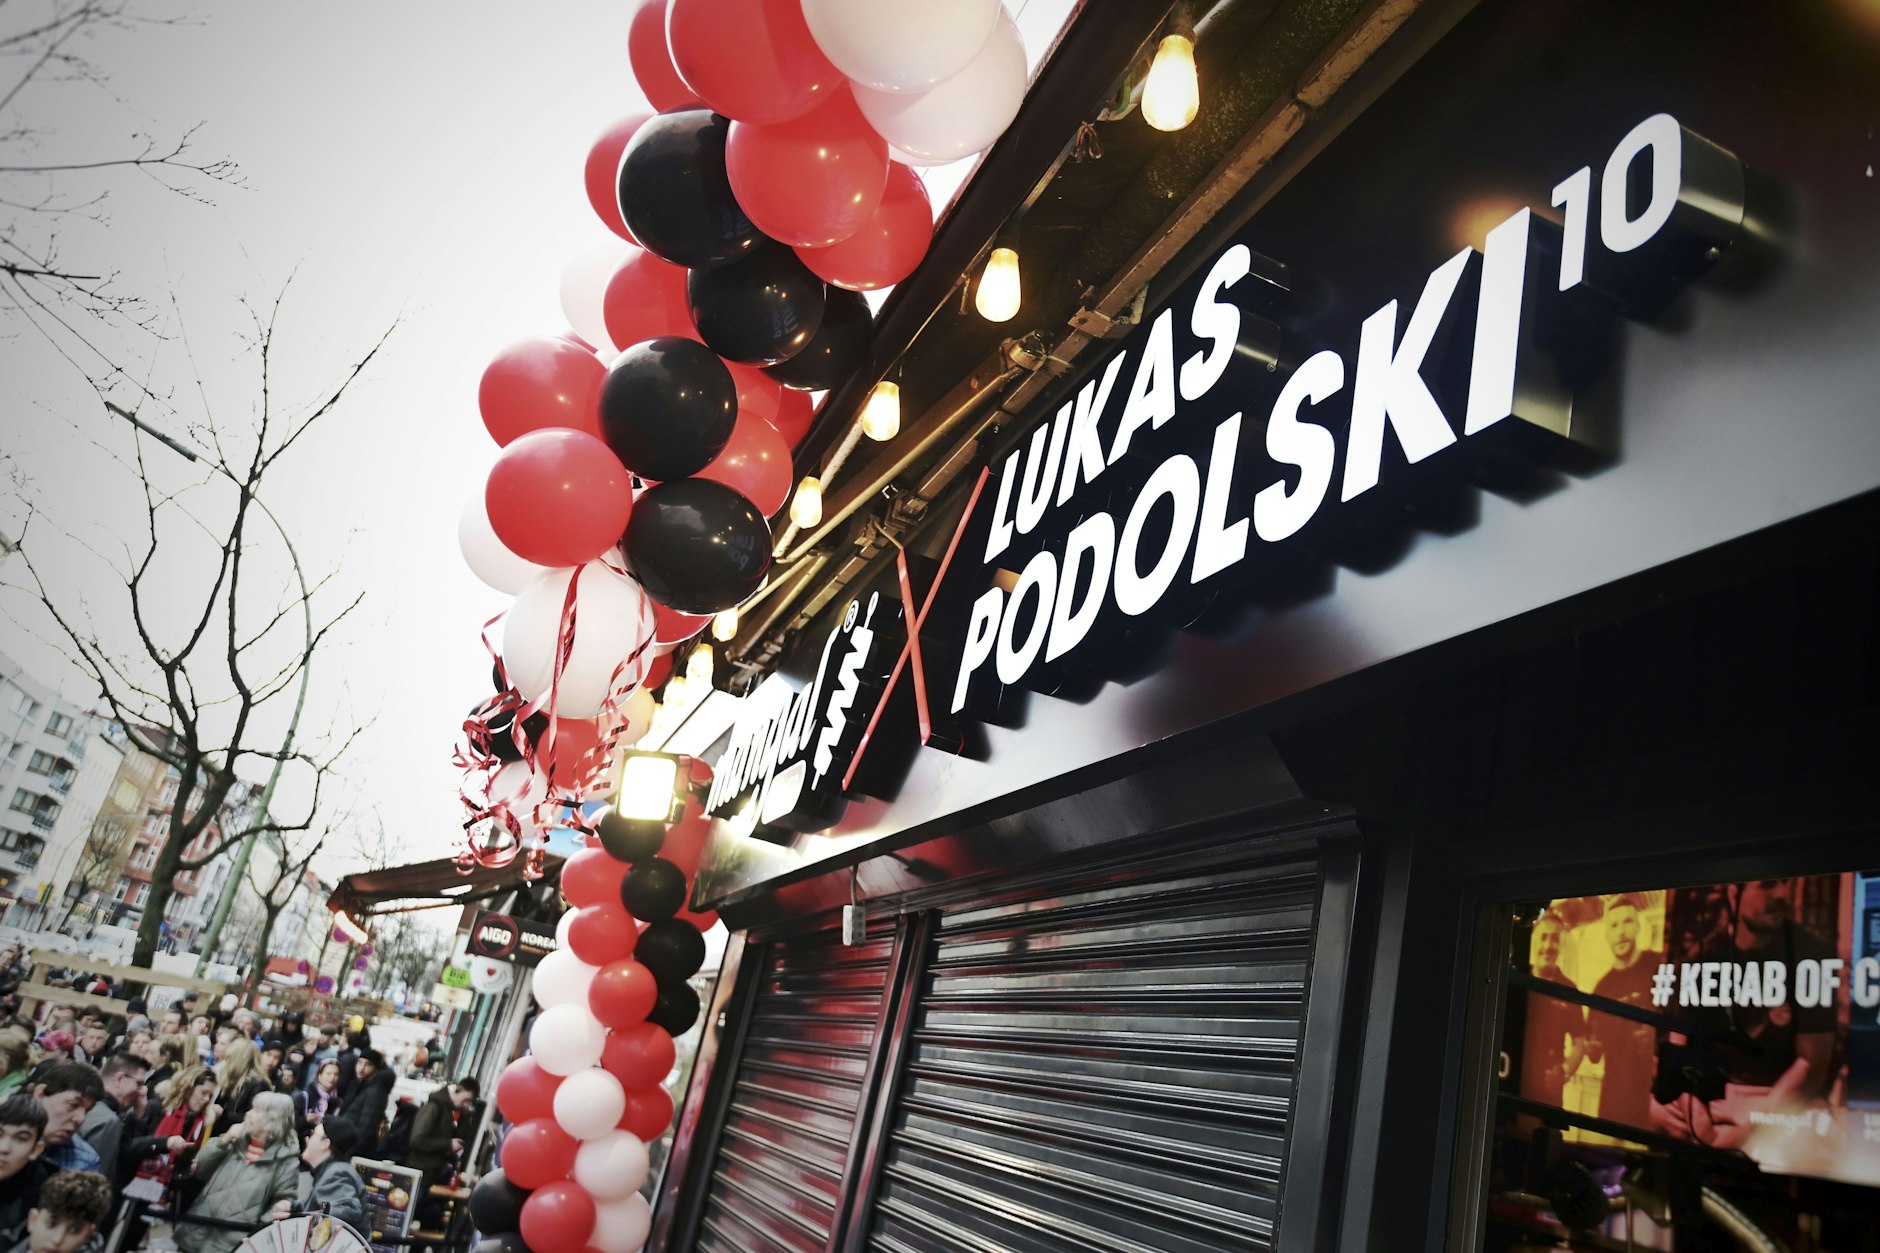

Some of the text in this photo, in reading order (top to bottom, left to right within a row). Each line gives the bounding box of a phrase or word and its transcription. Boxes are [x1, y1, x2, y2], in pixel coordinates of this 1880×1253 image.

[950, 113, 1680, 714] PODOLSKI 10
[984, 244, 1251, 564] LUKAS
[479, 926, 512, 946] AIGO
[520, 931, 559, 950] KOREA
[1795, 958, 1844, 1008] OF
